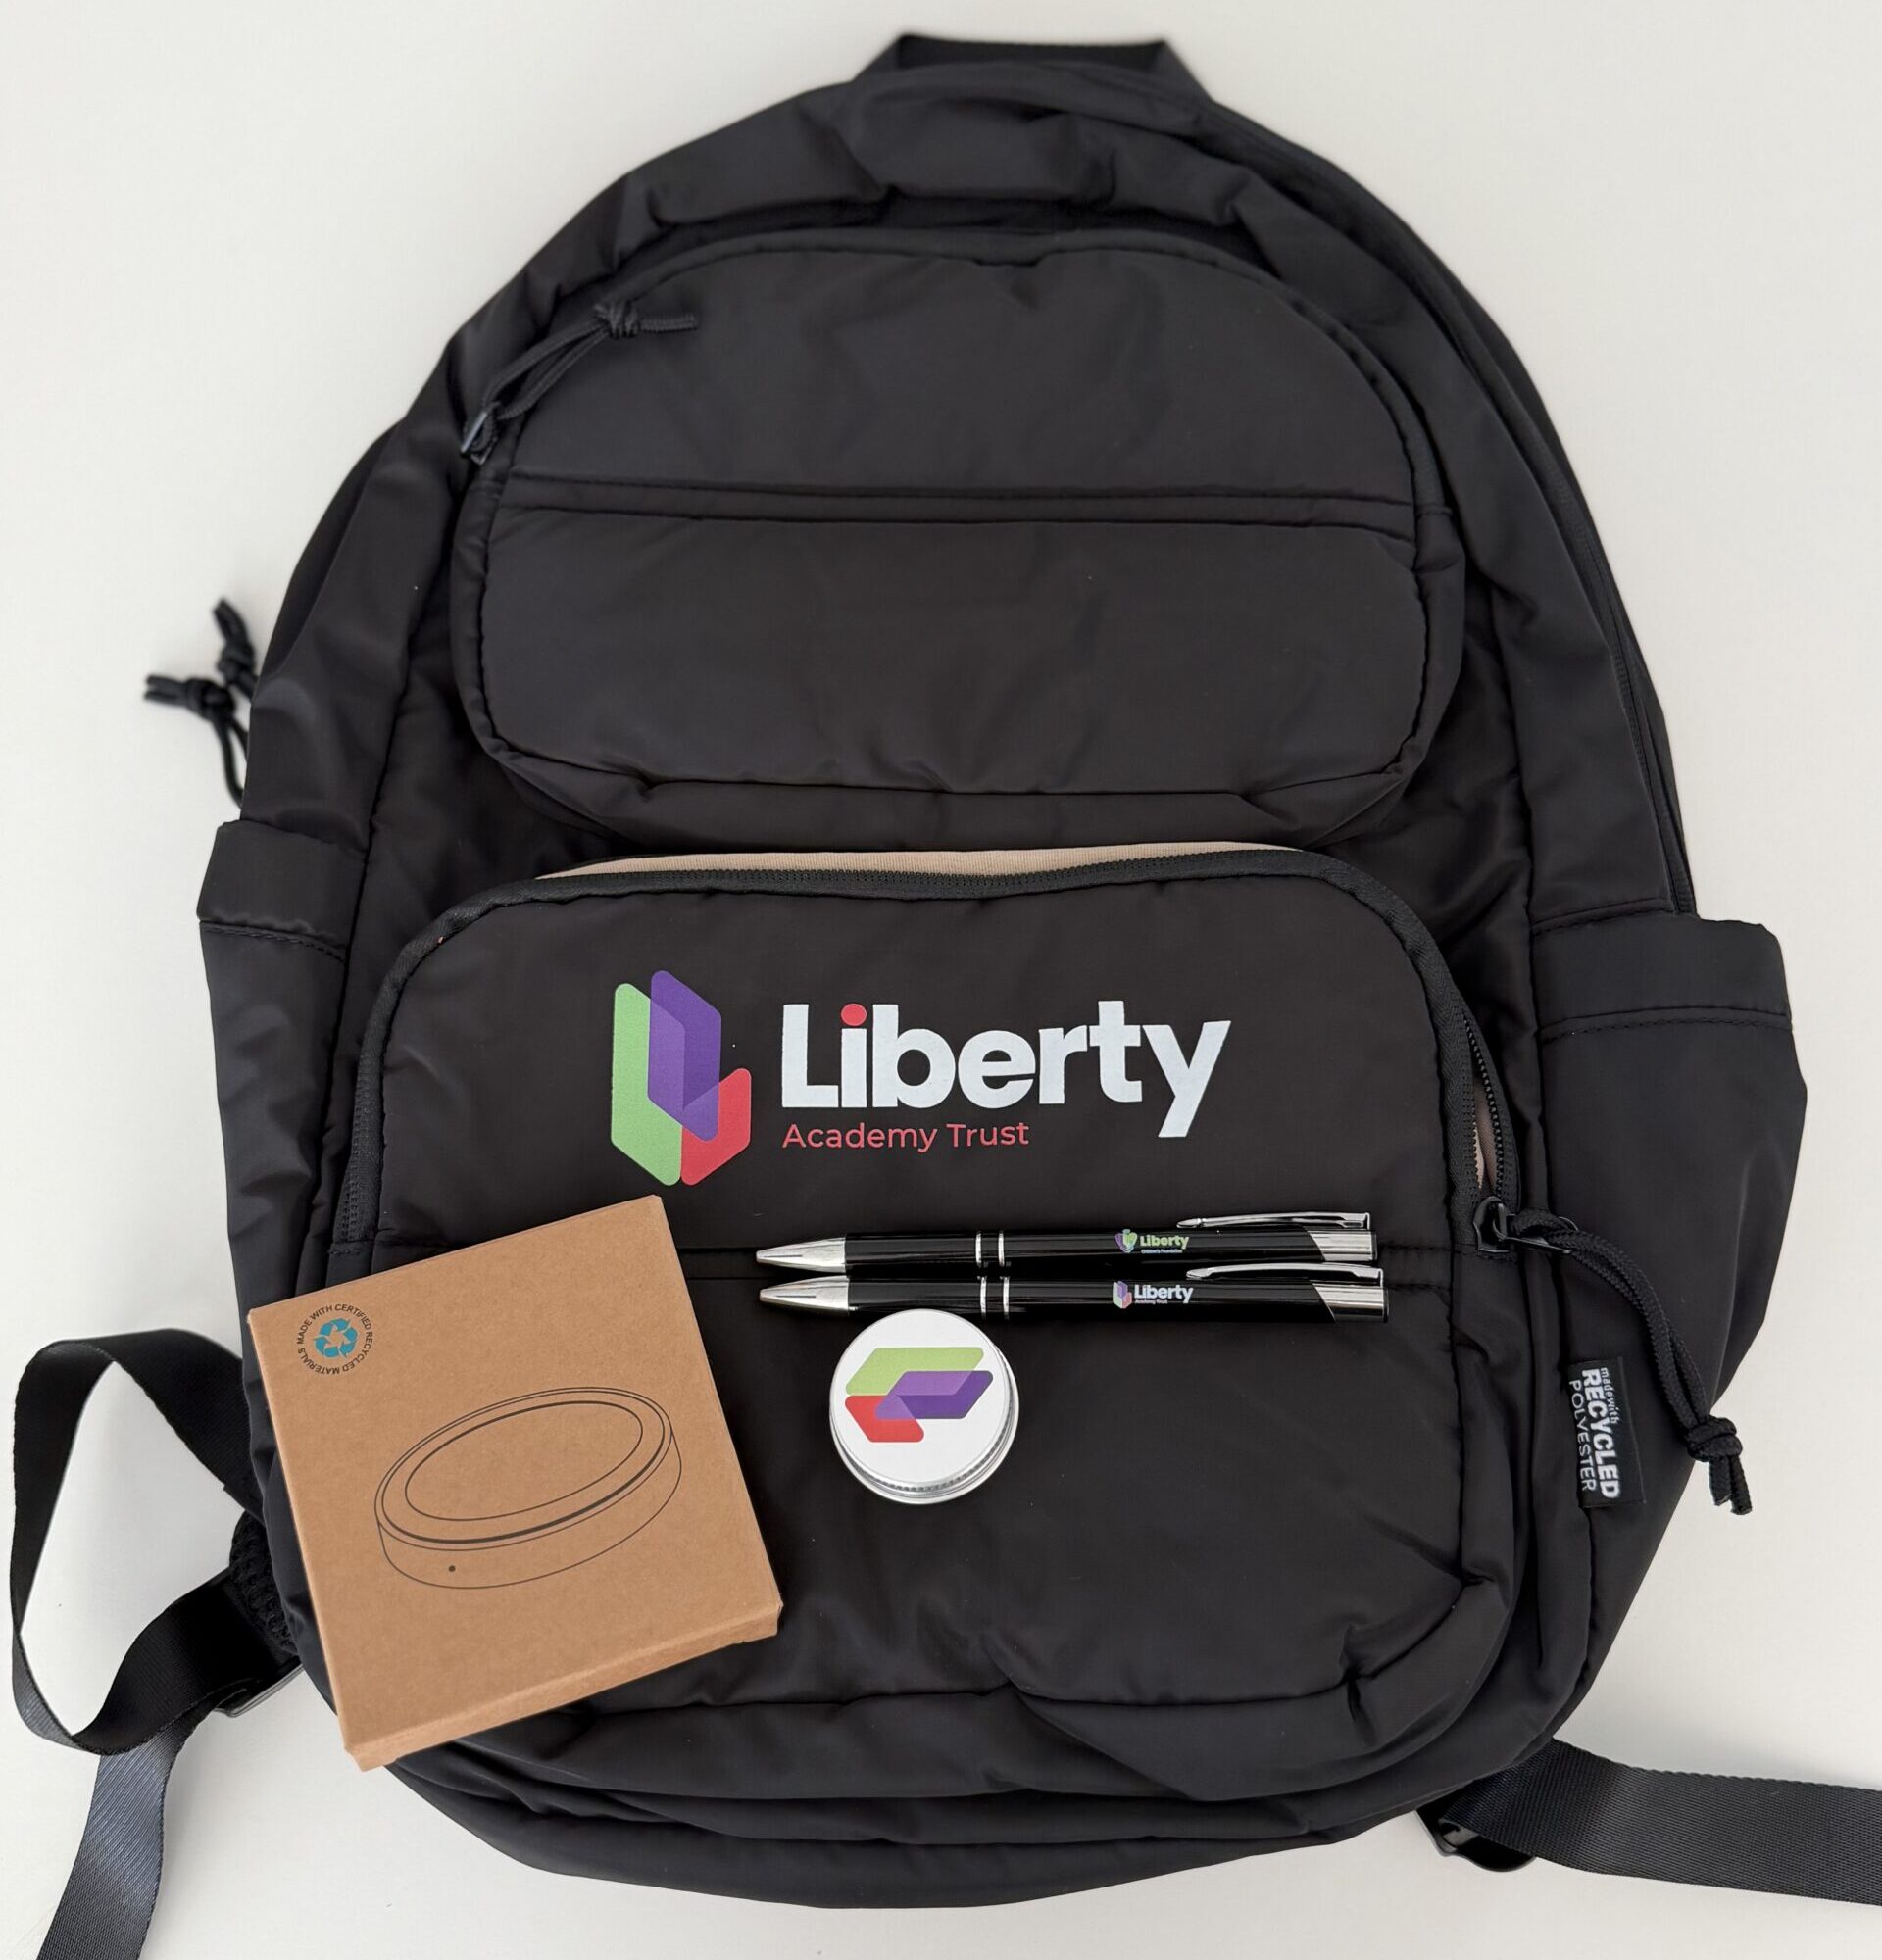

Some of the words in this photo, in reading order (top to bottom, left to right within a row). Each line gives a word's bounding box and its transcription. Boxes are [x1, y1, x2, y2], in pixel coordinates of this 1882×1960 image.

[781, 1000, 1231, 1138] Liberty
[781, 1122, 938, 1153] Academy
[946, 1122, 1029, 1147] Trust
[1139, 1234, 1190, 1250] Liberty
[1134, 1284, 1194, 1304] Liberty
[309, 1304, 333, 1320] WITH
[334, 1303, 372, 1330] CERTIFIED
[297, 1319, 313, 1344] MADE
[297, 1348, 340, 1375] MATERIALS
[342, 1331, 373, 1372] RECYCLED
[1600, 1367, 1613, 1397] made
[1607, 1396, 1620, 1424] with
[1581, 1368, 1621, 1498] RECYCLED
